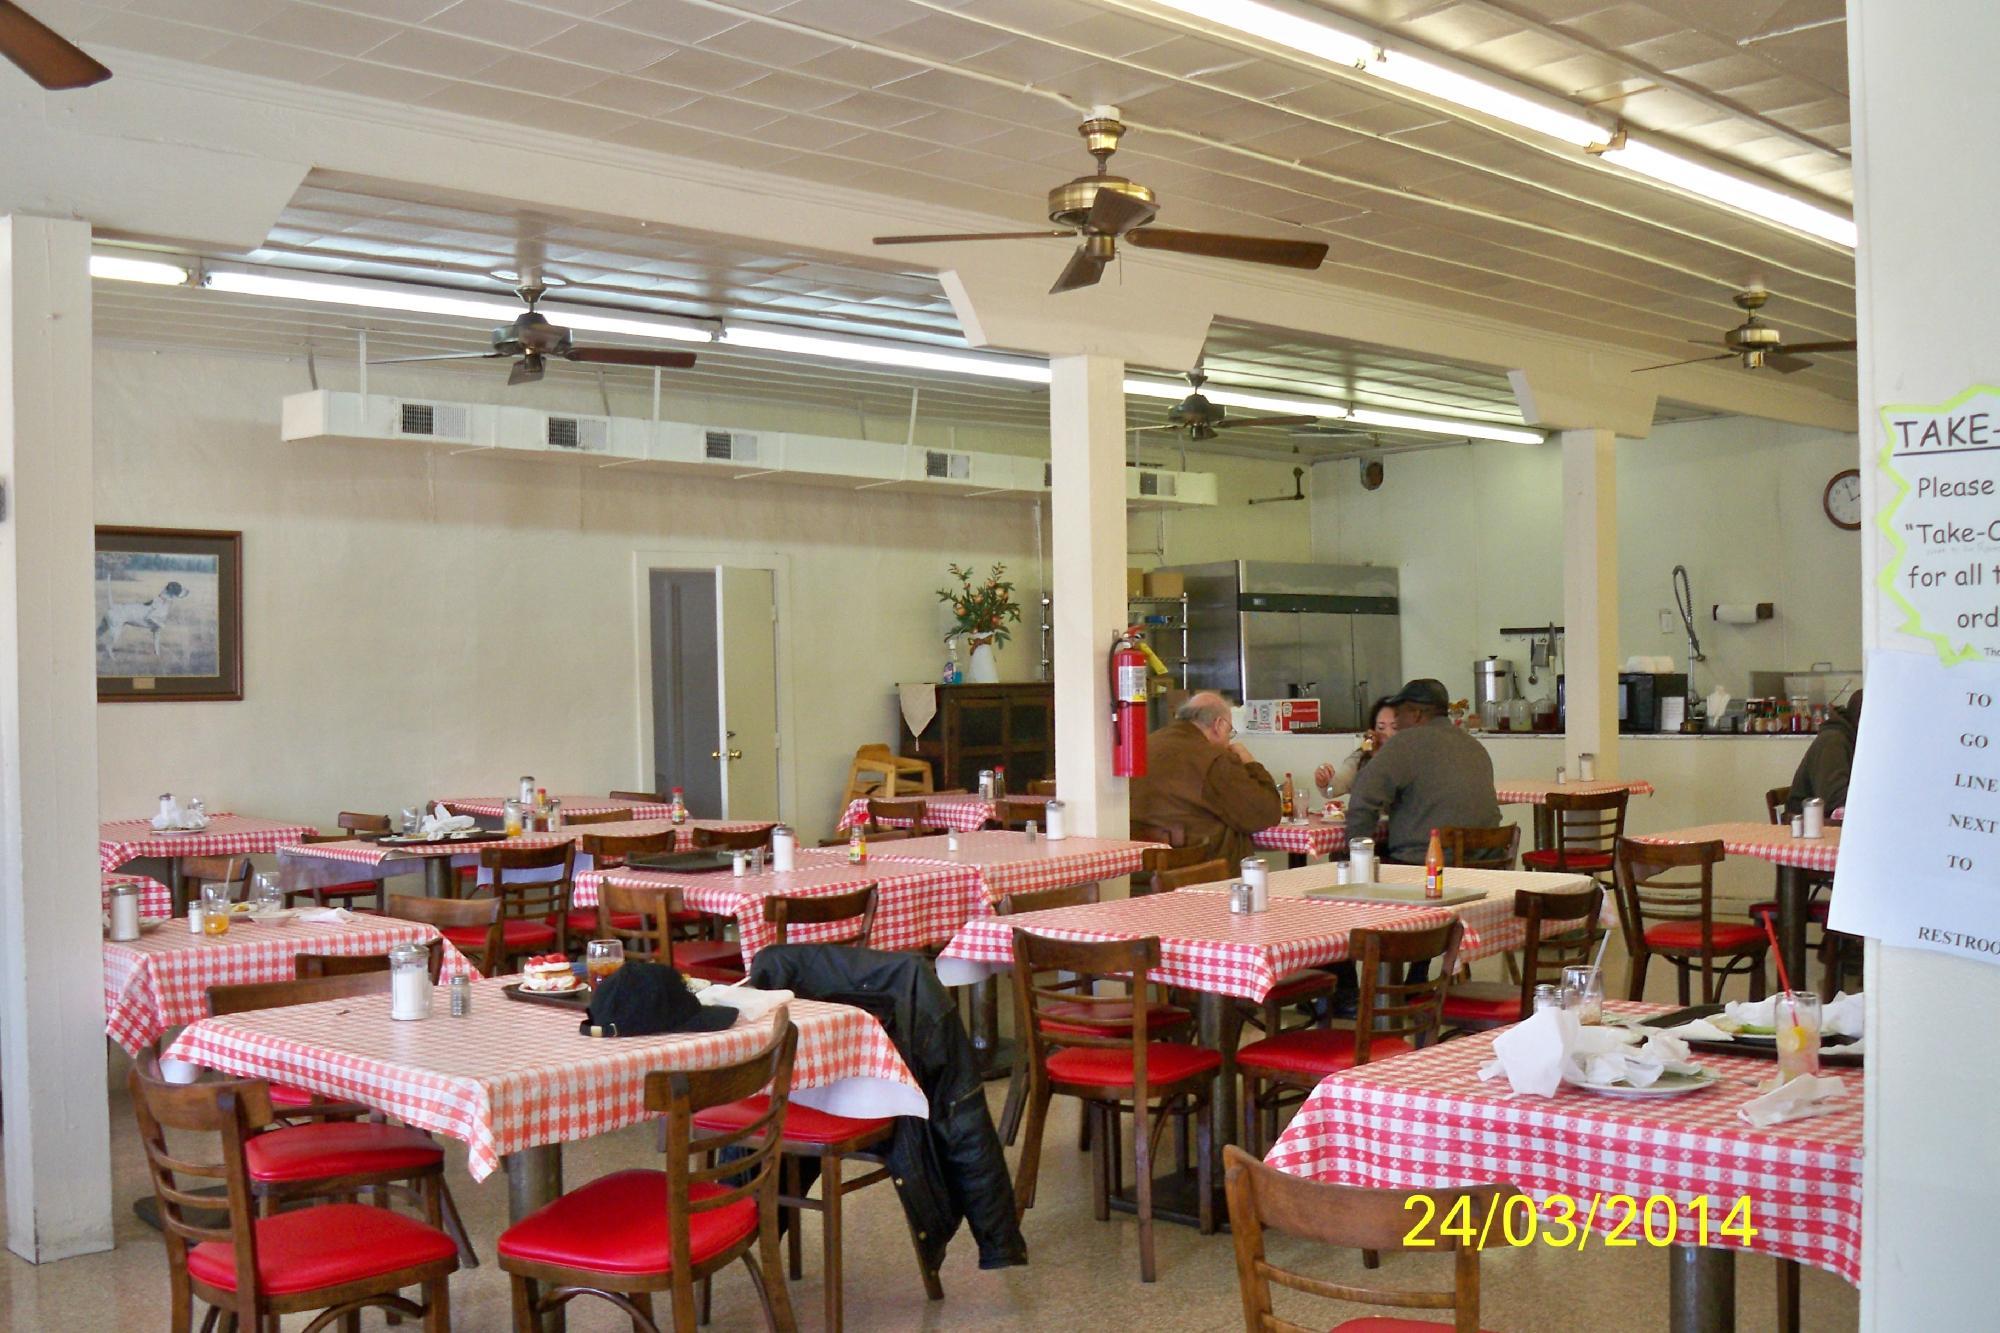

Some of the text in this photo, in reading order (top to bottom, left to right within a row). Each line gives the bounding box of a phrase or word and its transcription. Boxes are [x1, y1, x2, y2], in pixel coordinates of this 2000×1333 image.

[1918, 476, 1995, 498] Please
[1908, 565, 1946, 588] for
[1955, 563, 1982, 586] all
[1957, 605, 1999, 629] ord
[1966, 692, 1992, 708] TO
[1960, 733, 1988, 749] GO
[1954, 773, 1998, 793] LINE
[1949, 813, 1999, 834] NEXT
[1947, 854, 1973, 872] TO
[1918, 926, 2000, 956] RESTROO
